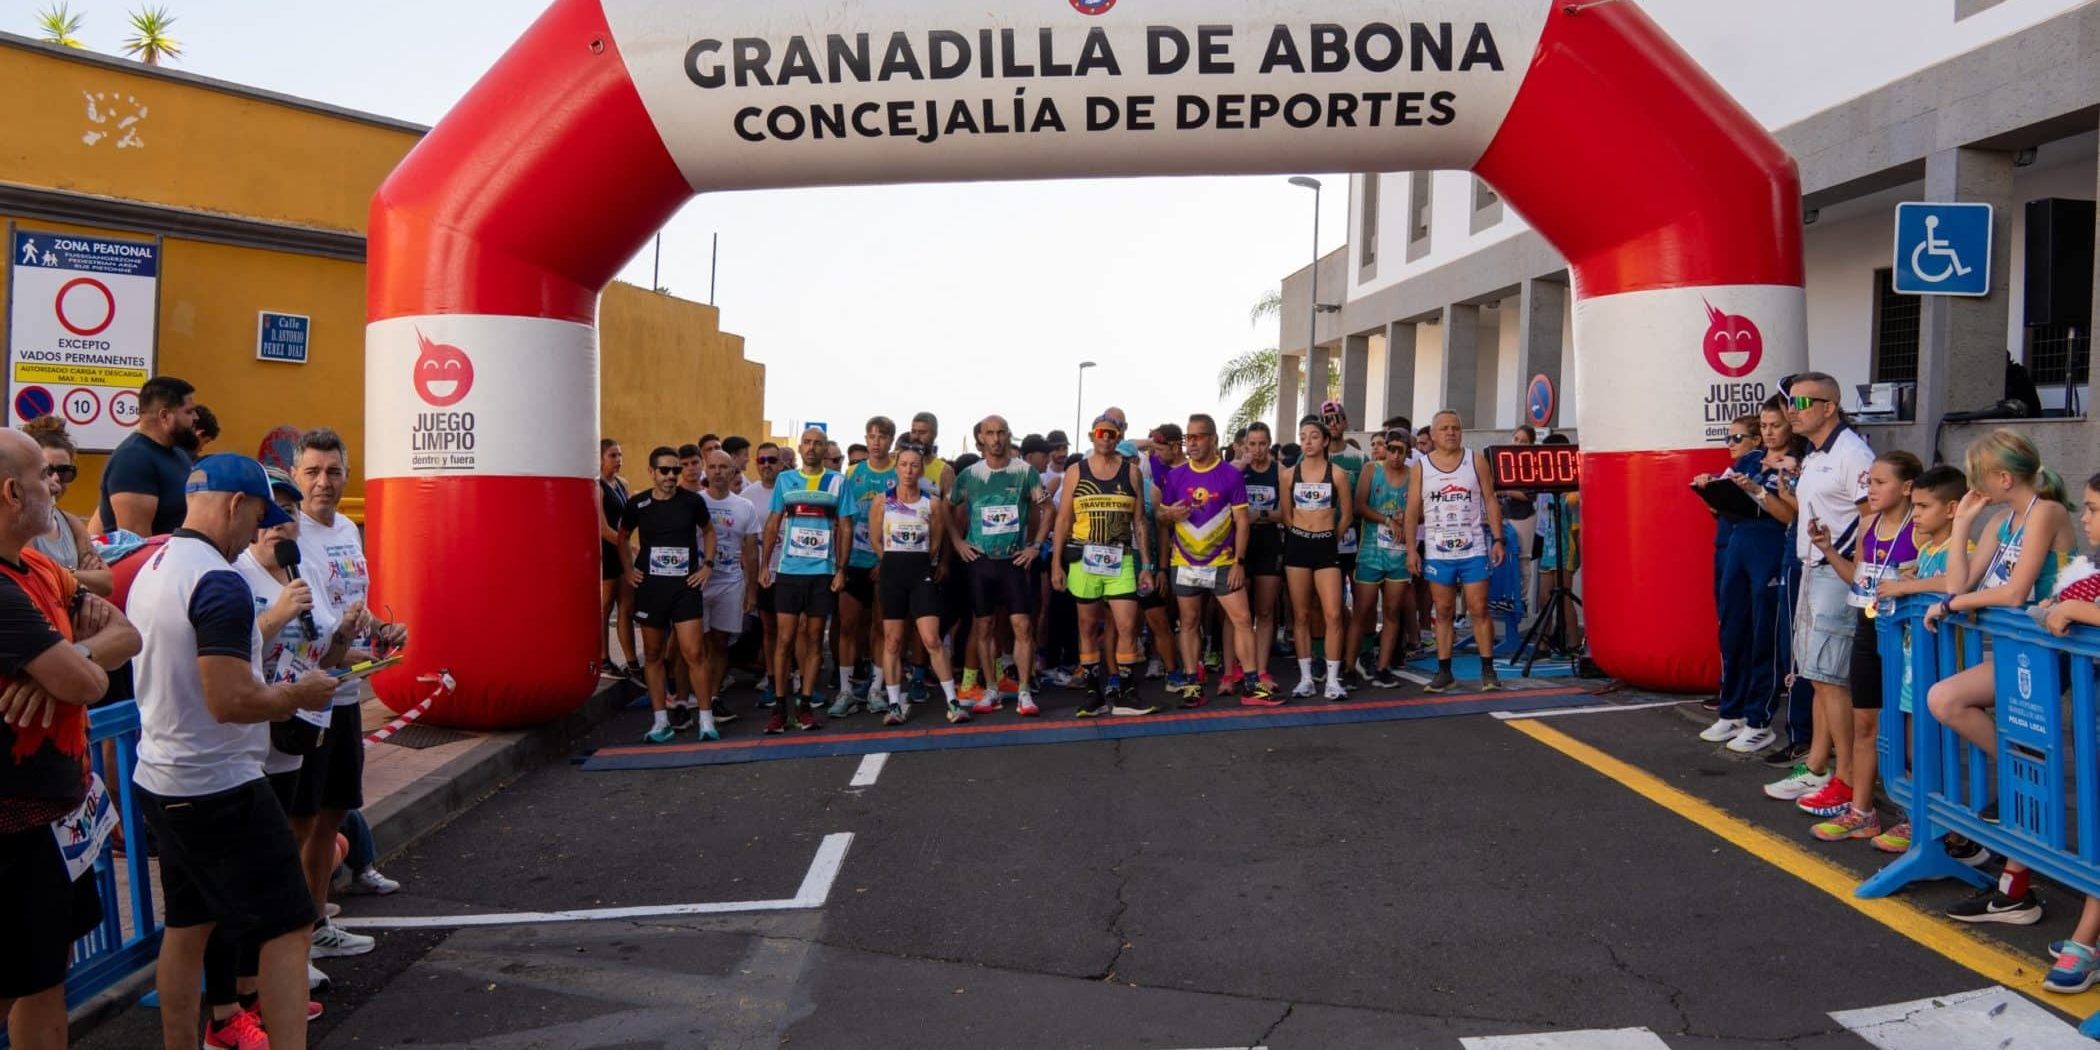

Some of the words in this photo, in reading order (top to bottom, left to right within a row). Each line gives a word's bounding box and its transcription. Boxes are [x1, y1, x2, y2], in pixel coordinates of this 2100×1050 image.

[684, 27, 1122, 89] GRANADILLA
[1146, 25, 1235, 75] DE
[1259, 22, 1504, 75] ABONA
[734, 87, 1066, 143] CONCEJALÍA
[1086, 96, 1155, 131] DE
[1176, 91, 1456, 130] DEPORTES
[54, 238, 90, 252] ZONA
[93, 243, 153, 258] PEATONAL
[279, 317, 300, 329] Calle
[58, 338, 110, 351] EXCEPTO
[20, 350, 61, 362] VADOS
[65, 353, 145, 367] PERMANENTES
[20, 365, 68, 374] AUTORIZADO
[70, 367, 97, 376] CARGA
[104, 369, 144, 378] DESCARGA
[1704, 382, 1765, 403] JUEGO
[73, 400, 91, 414] 10
[412, 412, 475, 432] JUEGO
[1705, 427, 1729, 436] dentr
[412, 431, 475, 451] LIMPIO
[412, 455, 440, 465] dentro
[442, 456, 448, 466] y
[450, 454, 475, 464] fuera
